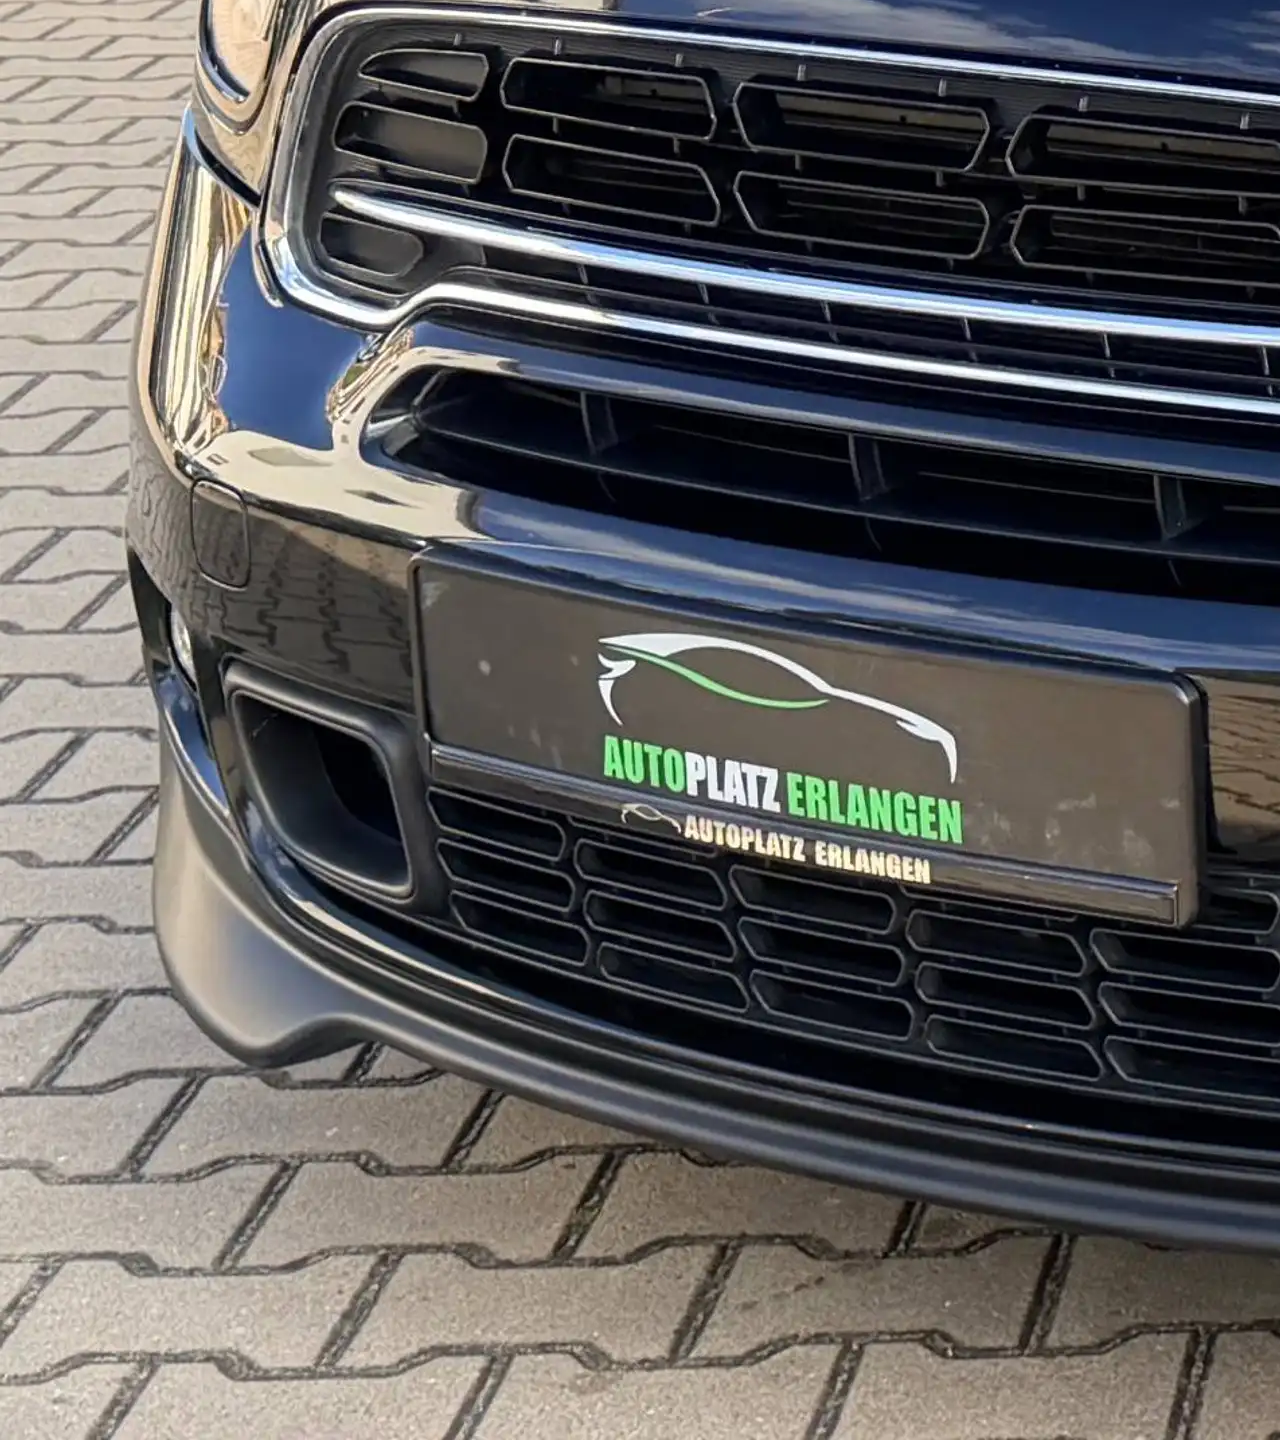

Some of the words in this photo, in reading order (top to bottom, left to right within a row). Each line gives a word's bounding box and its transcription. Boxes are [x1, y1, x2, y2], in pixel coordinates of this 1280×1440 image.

[604, 733, 781, 813] AUTOPLATZ
[786, 771, 963, 846] ERLANGEN
[684, 814, 807, 863] AUTOPLATZ
[815, 840, 931, 885] ERLANGEN
